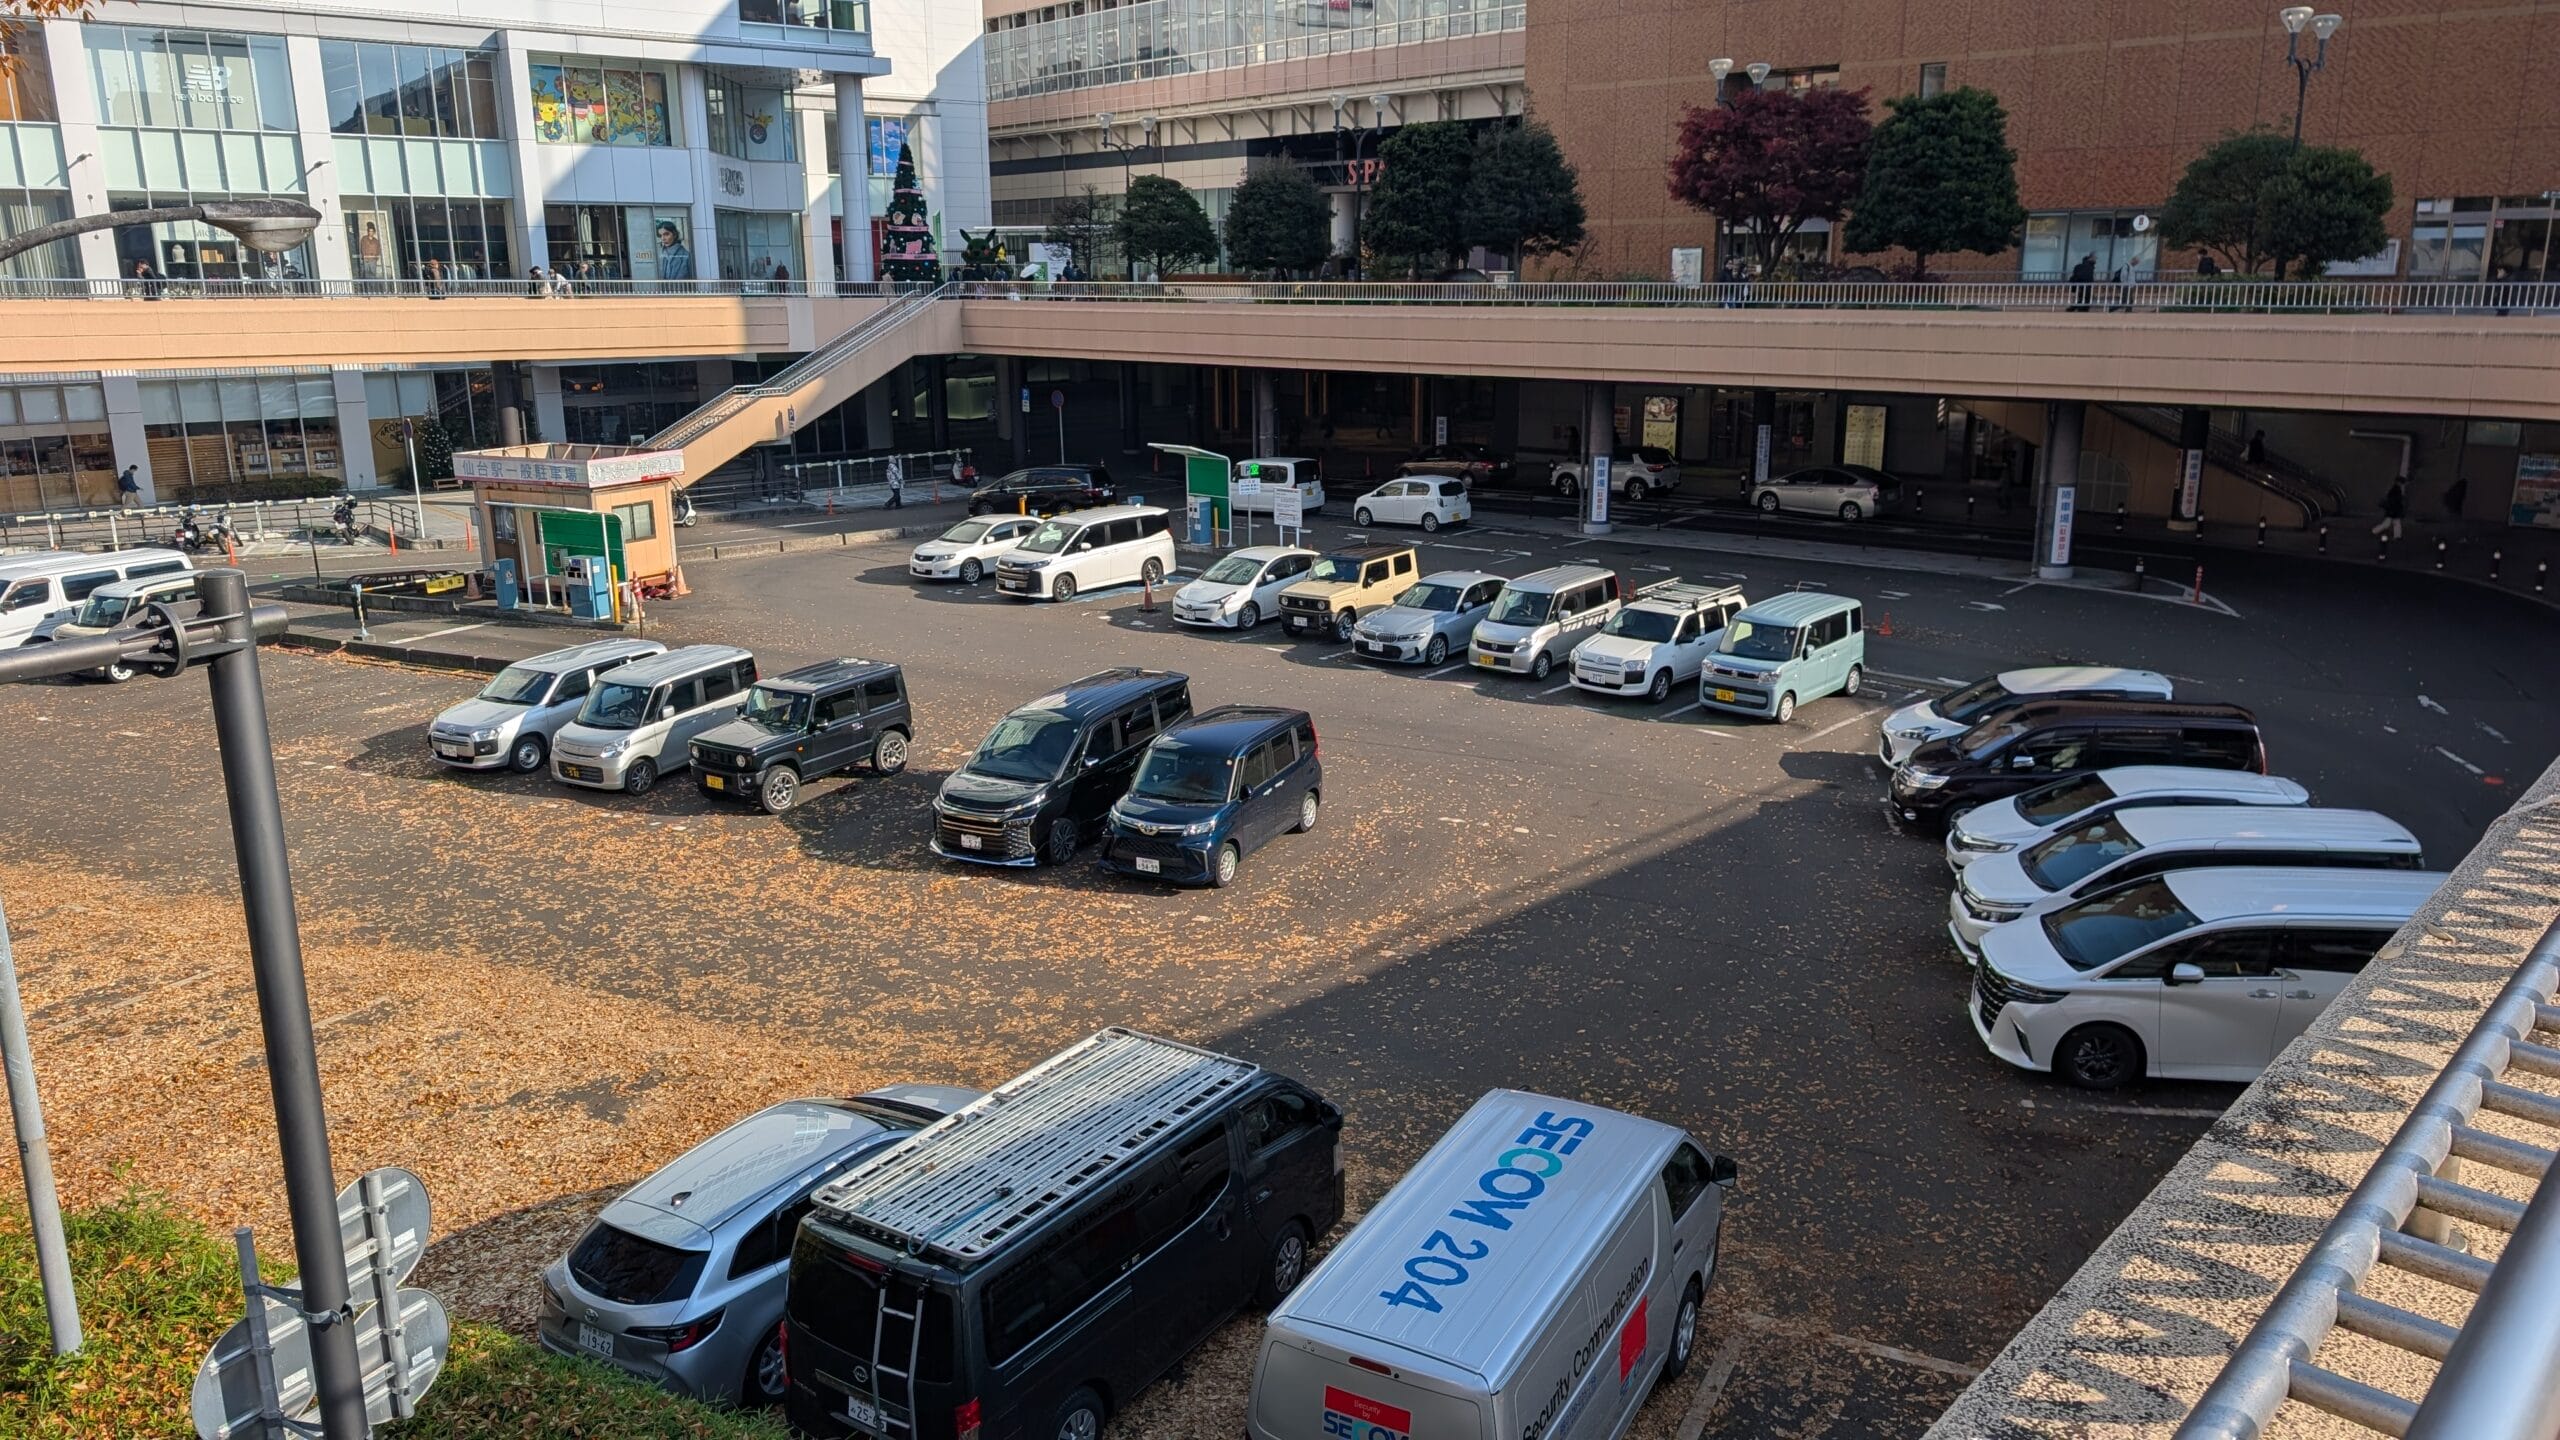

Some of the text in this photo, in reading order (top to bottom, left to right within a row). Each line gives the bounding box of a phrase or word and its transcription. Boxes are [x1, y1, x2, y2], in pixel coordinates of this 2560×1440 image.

[197, 92, 244, 104] balance
[463, 460, 577, 482] 仙台駅一般駐車場
[1379, 1111, 1595, 1314] SECOM 204
[587, 1335, 611, 1355] 19-62
[1522, 1371, 1571, 1440] Security
[1573, 1257, 1649, 1378] Communication
[1353, 1399, 1381, 1416] Security
[1362, 1410, 1371, 1420] by
